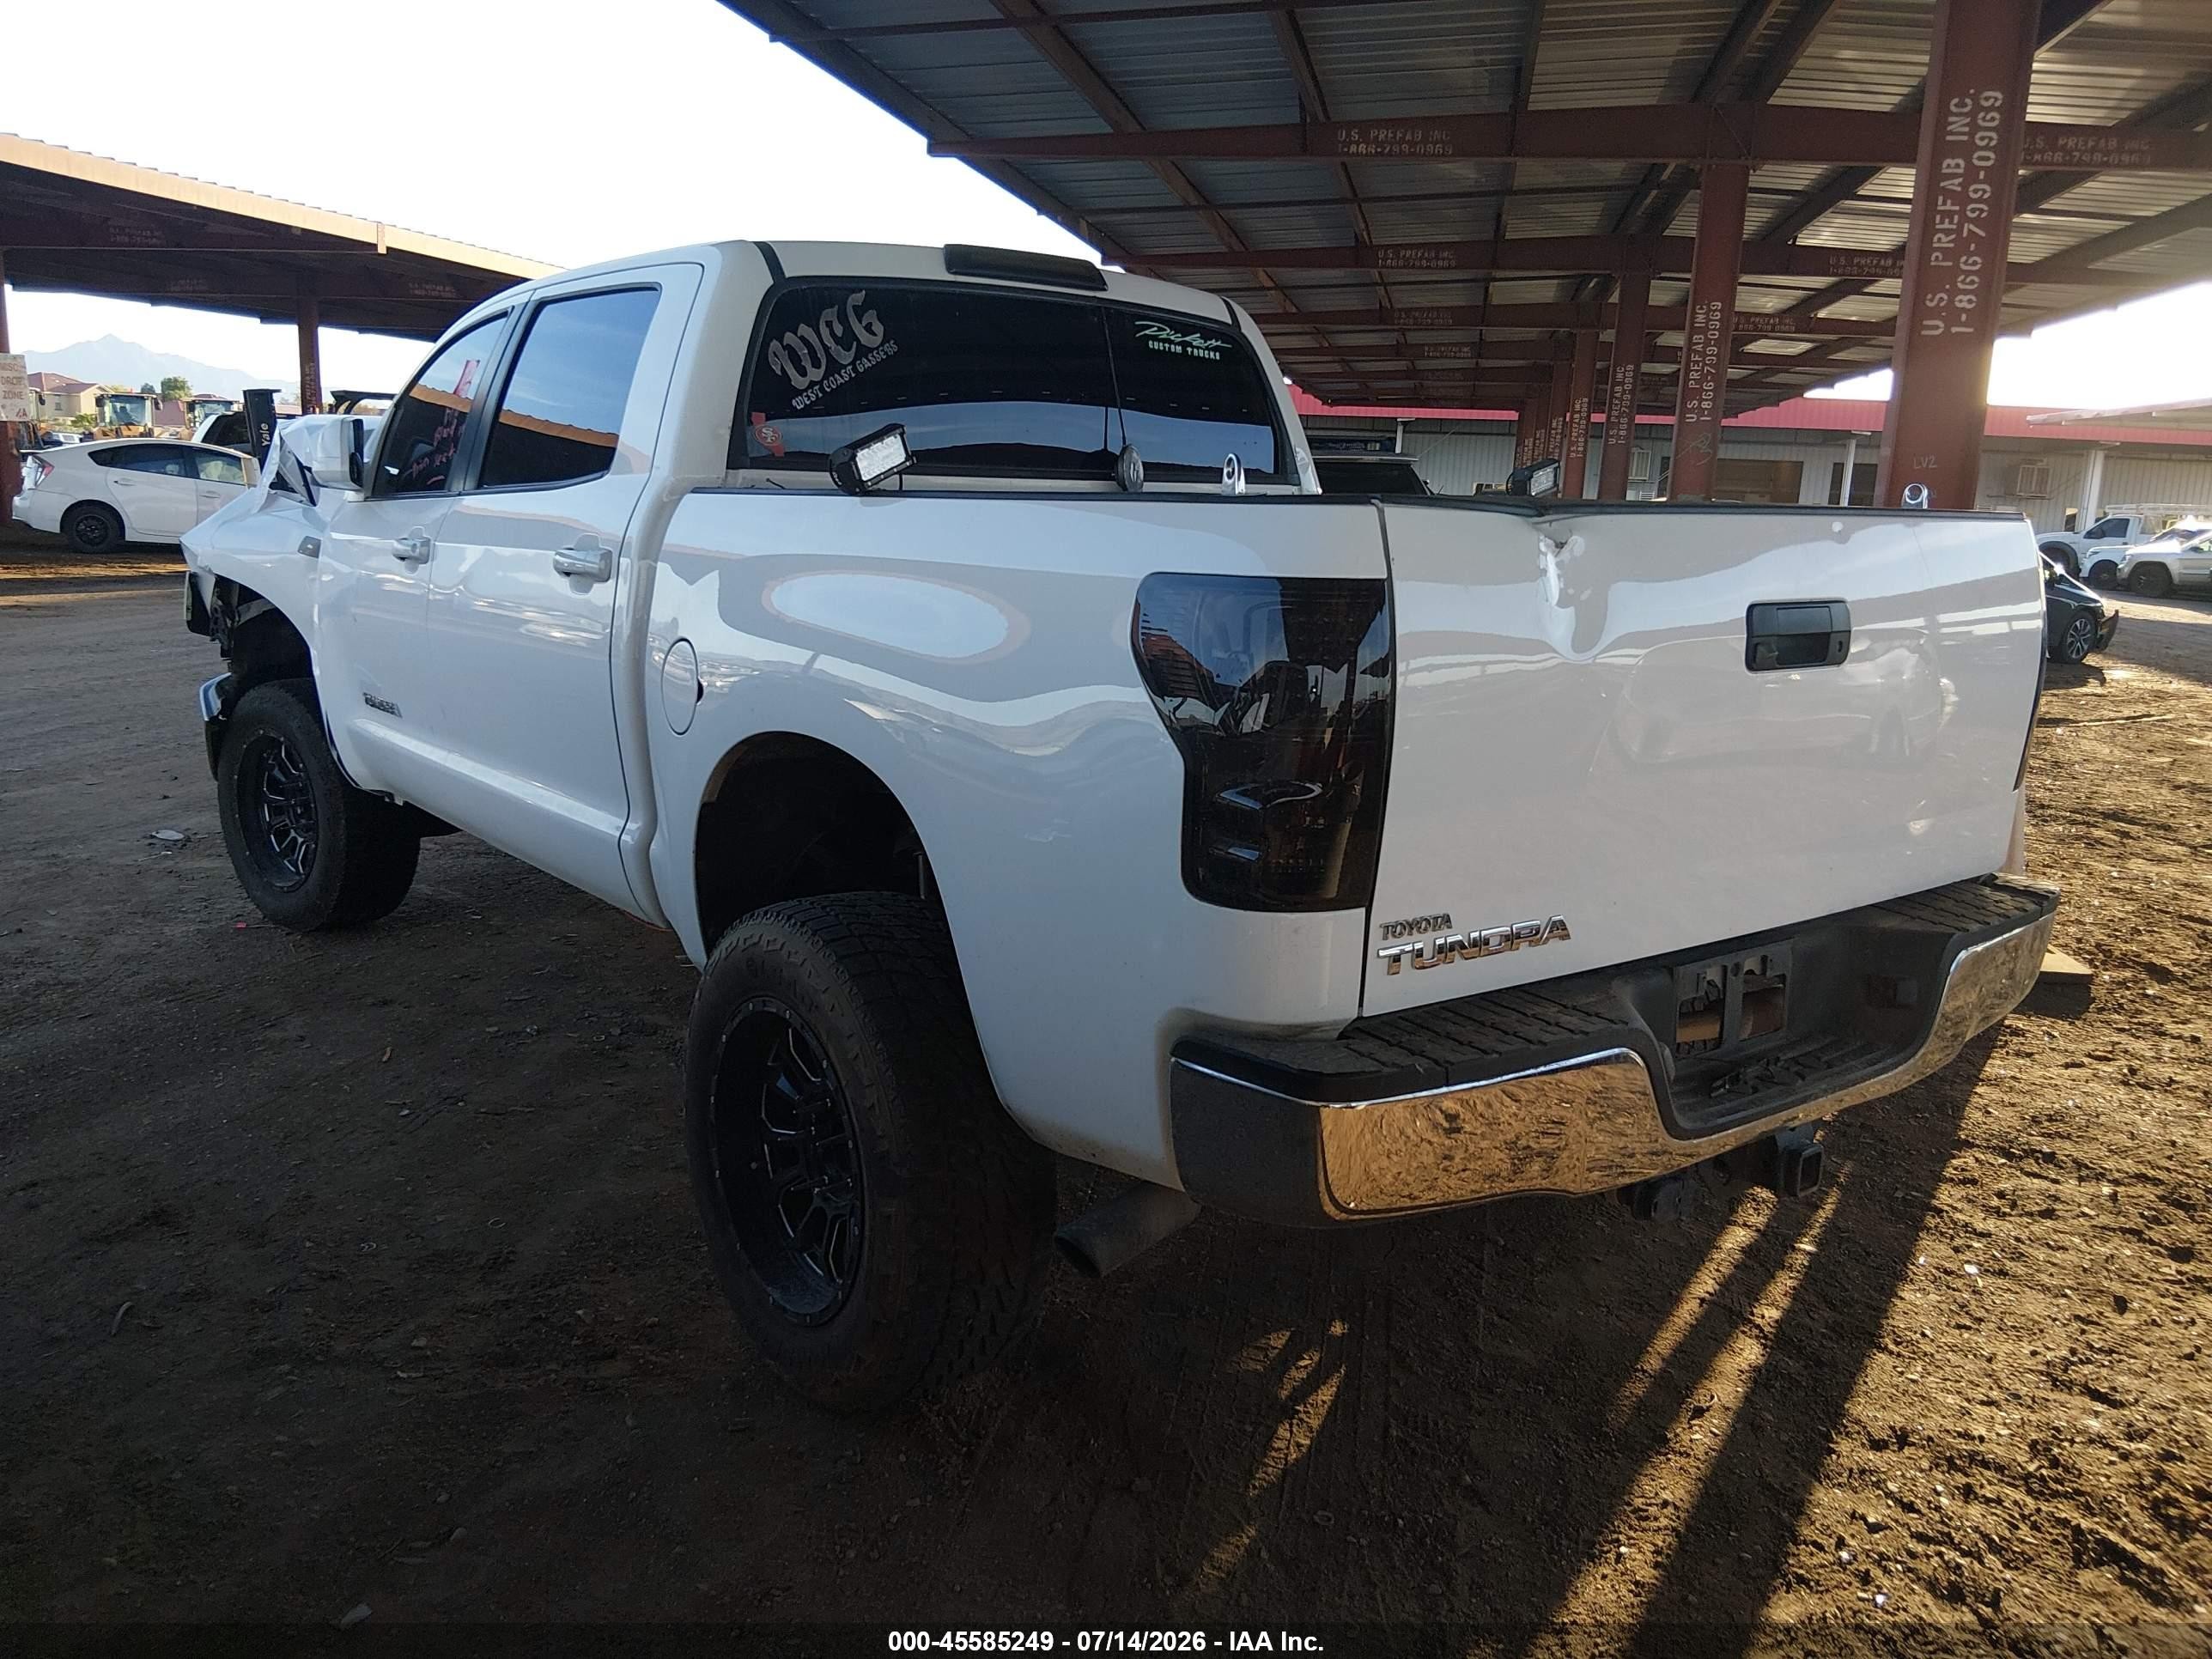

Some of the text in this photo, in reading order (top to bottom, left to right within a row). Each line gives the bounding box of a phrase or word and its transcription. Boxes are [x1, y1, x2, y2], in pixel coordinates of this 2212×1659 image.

[1370, 129, 1422, 142] PREFAB
[2057, 136, 2118, 150] PREFAB
[1920, 88, 1975, 336] U.S. PREFAB INC.
[1950, 90, 2003, 334] 1-866-799-0969
[768, 289, 885, 391] WCG
[1148, 340, 1220, 361] CUSTOM TRUCKS
[1688, 333, 1705, 389] PREFAB
[1699, 301, 1722, 421] 1-866-799-0969
[3, 391, 25, 400] ZONE
[791, 340, 899, 410] WEST COAST GASSERS
[259, 423, 271, 447] Yale
[1376, 915, 1572, 976] TUNDRA
[1379, 913, 1454, 941] TOYOTA
